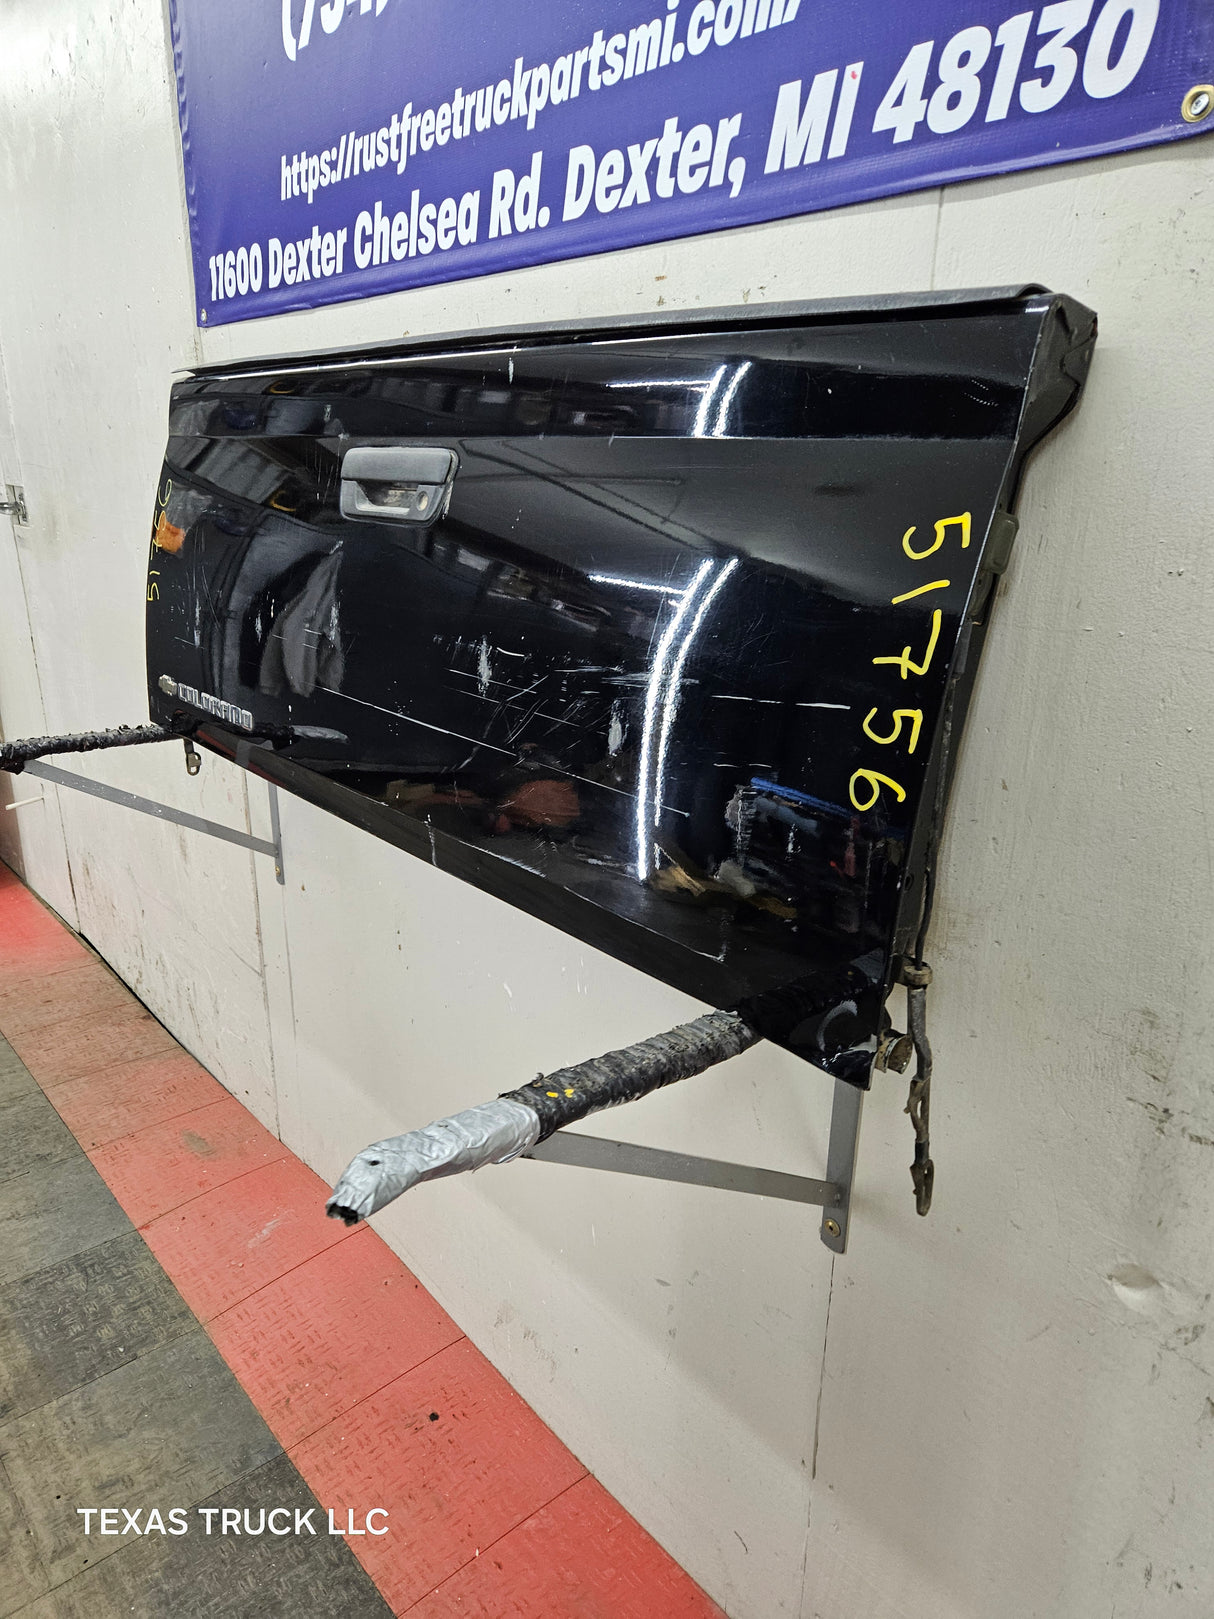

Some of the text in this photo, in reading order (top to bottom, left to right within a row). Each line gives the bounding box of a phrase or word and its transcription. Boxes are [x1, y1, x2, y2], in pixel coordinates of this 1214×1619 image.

[209, 0, 1160, 301] 11600 Dexter Chelsea Rd. Dexter, MI 48130
[849, 511, 971, 811] 51756
